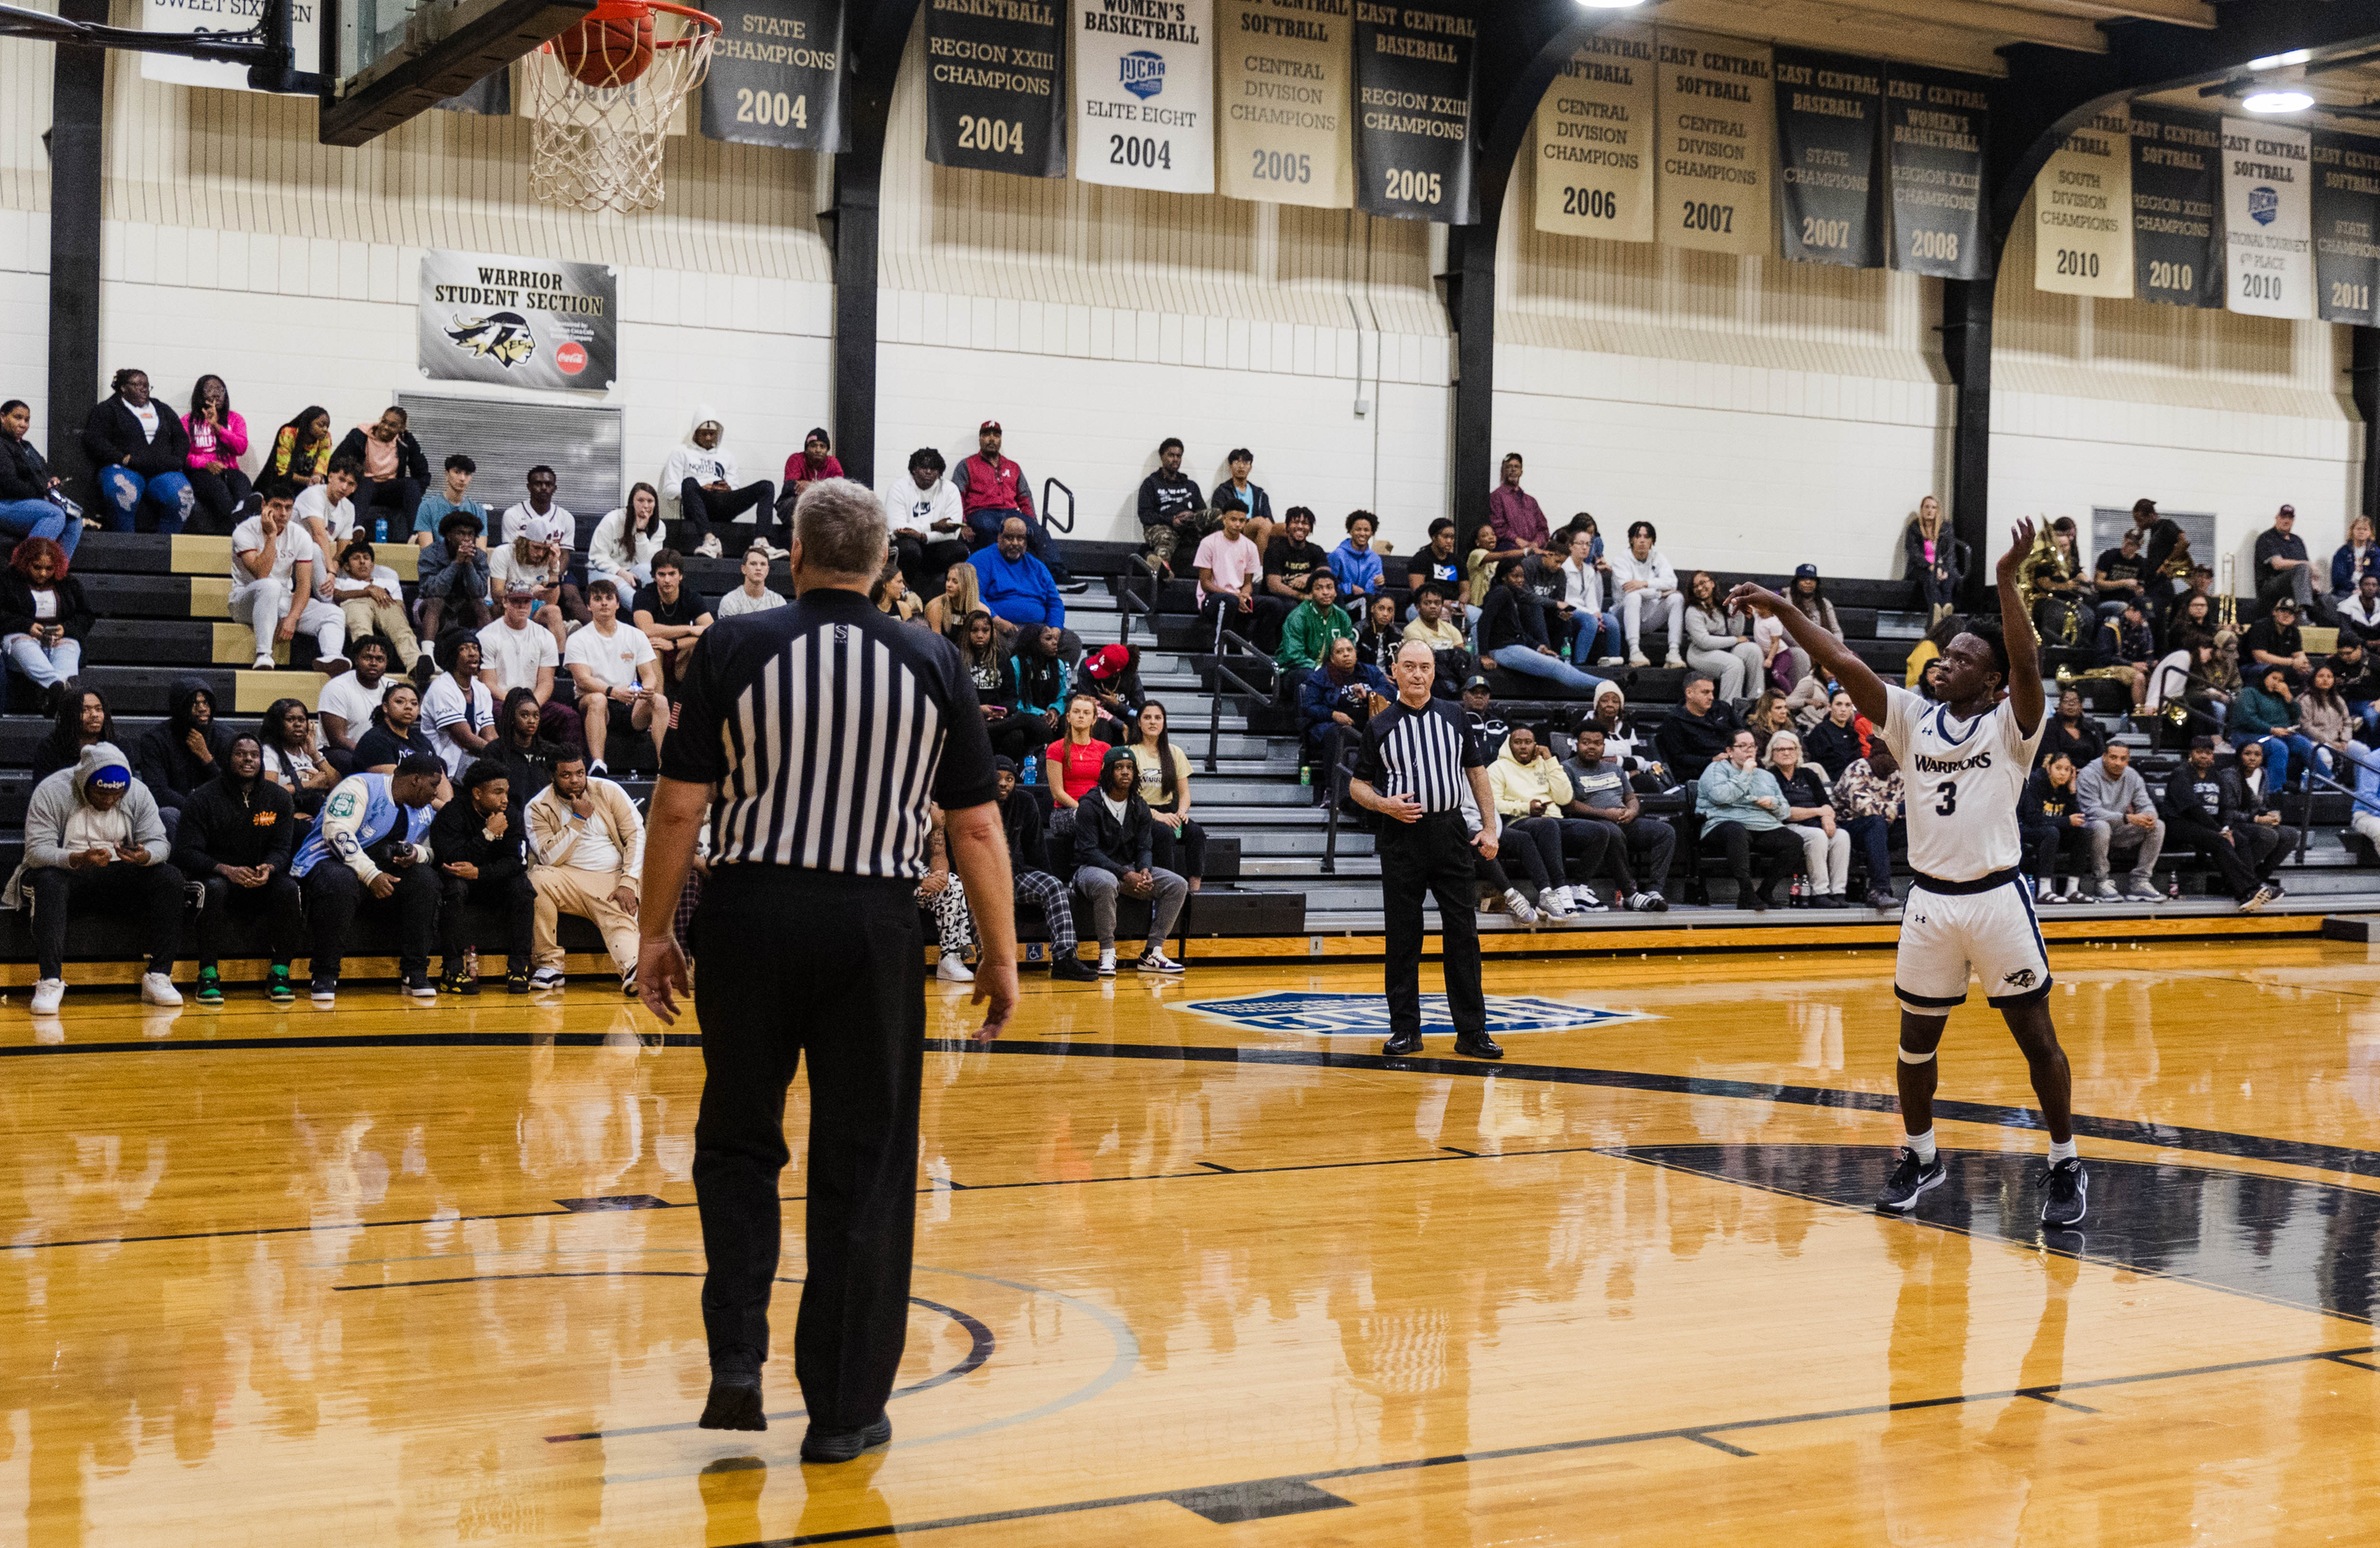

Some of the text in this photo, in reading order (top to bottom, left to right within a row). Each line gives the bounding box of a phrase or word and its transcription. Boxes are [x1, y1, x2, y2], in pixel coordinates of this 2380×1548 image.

[933, 0, 1054, 26] BASKETBALL
[1103, 0, 1185, 21] WOMEN'S
[1356, 2, 1477, 38] EAST CENTRAL
[742, 14, 806, 39] STATE
[1084, 11, 1199, 45] BASKETBALL
[1241, 12, 1328, 42] SOFTBALL
[711, 37, 836, 71] CHAMPIONS
[930, 36, 1055, 71] REGION XXIII
[1376, 33, 1457, 63] BASEBALL
[1659, 45, 1768, 79] EAST CENTRAL
[933, 63, 1050, 96] CHAMPIONS
[1244, 55, 1325, 80] CENTRAL
[1777, 64, 1880, 95] EAST CENTRAL
[1245, 80, 1323, 105] DIVISION
[1361, 86, 1468, 117] REGION XXIII
[1676, 75, 1751, 103] SOFTBALL
[1888, 79, 1923, 101] EAST
[736, 87, 807, 129] 2004
[1087, 100, 1197, 128] ELITE EIGHT
[1230, 104, 1336, 132] CHAMPIONS
[1556, 98, 1629, 122] CENTRAL
[1793, 93, 1864, 119] BASEBALL
[958, 115, 1024, 155] 2004
[1364, 112, 1465, 141] CHAMPIONS
[1556, 122, 1627, 144] DIVISION
[1678, 114, 1747, 139] CENTRAL
[1894, 125, 1980, 152] BASKETBALL
[1110, 134, 1171, 170] 2004
[1544, 144, 1639, 170] CHAMPIONS
[1677, 137, 1745, 160] DIVISION
[1806, 147, 1849, 167] STATE
[1252, 149, 1311, 184] 2005
[1664, 159, 1757, 185] CHAMPIONS
[1783, 167, 1869, 192] CHAMPIONS
[2234, 160, 2295, 182] SOFTBALL
[1385, 168, 1441, 204] 2005
[1563, 186, 1616, 219] 2006
[1683, 201, 1733, 233] 2007
[2040, 211, 2119, 232] CHAMPIONS
[1802, 217, 1849, 249] 2007
[1911, 229, 1959, 261] 2008
[2057, 249, 2099, 277] 2010
[2150, 261, 2192, 291] 2010
[478, 267, 562, 291] WARRIOR
[2243, 273, 2281, 300] 2010
[435, 285, 603, 316] STUDENT SECTION
[2332, 283, 2369, 310] 2011
[1914, 752, 1992, 773] WARRIORS
[1935, 781, 1957, 816] 3
